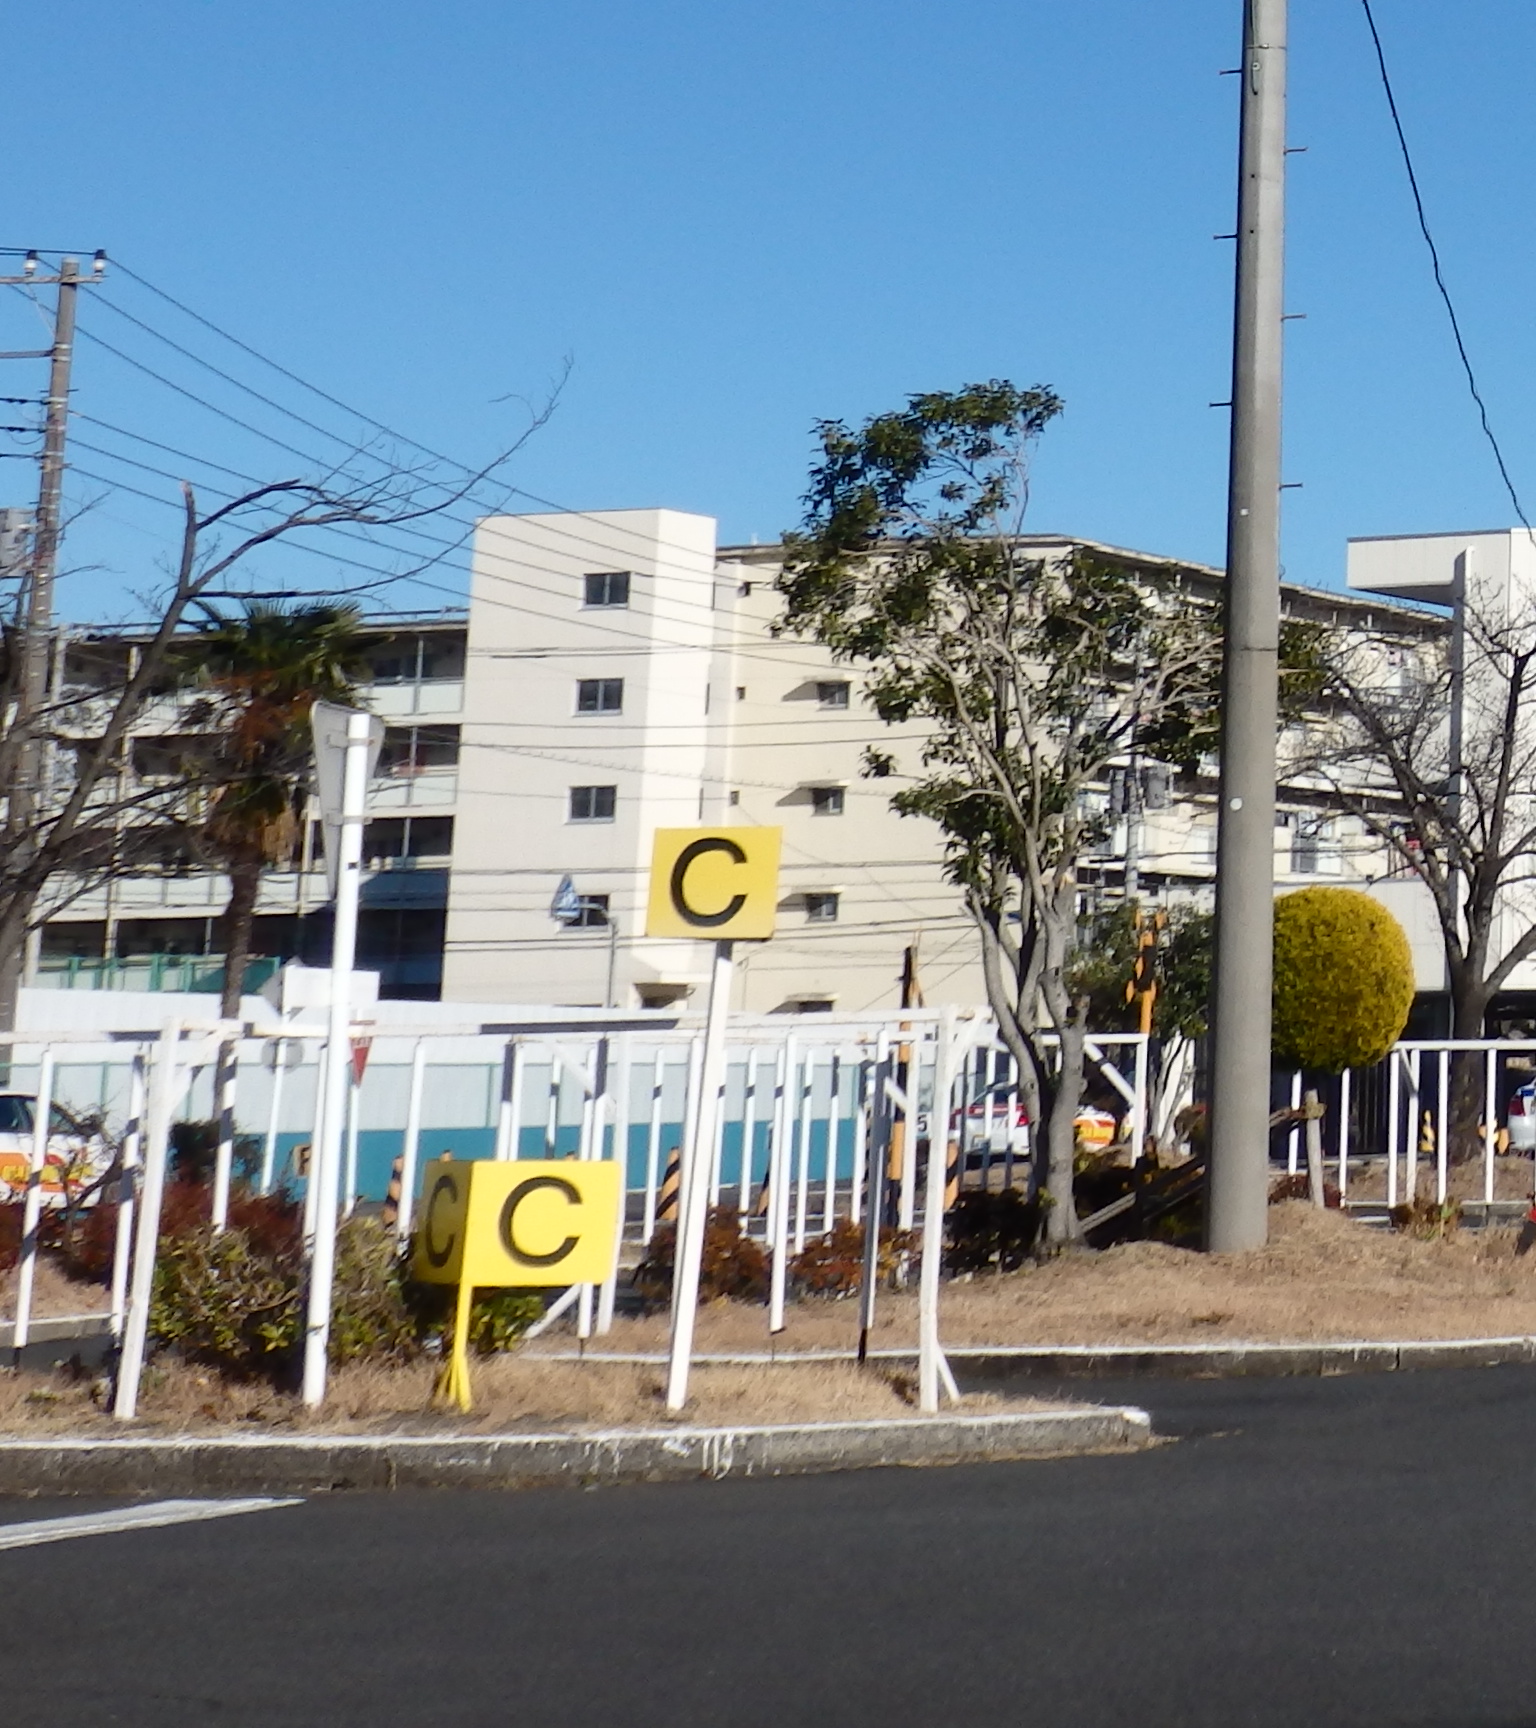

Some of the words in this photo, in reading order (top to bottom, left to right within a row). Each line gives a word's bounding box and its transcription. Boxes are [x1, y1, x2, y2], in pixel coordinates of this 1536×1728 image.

[670, 837, 749, 928] C
[425, 1176, 458, 1267] C
[498, 1175, 583, 1267] C
